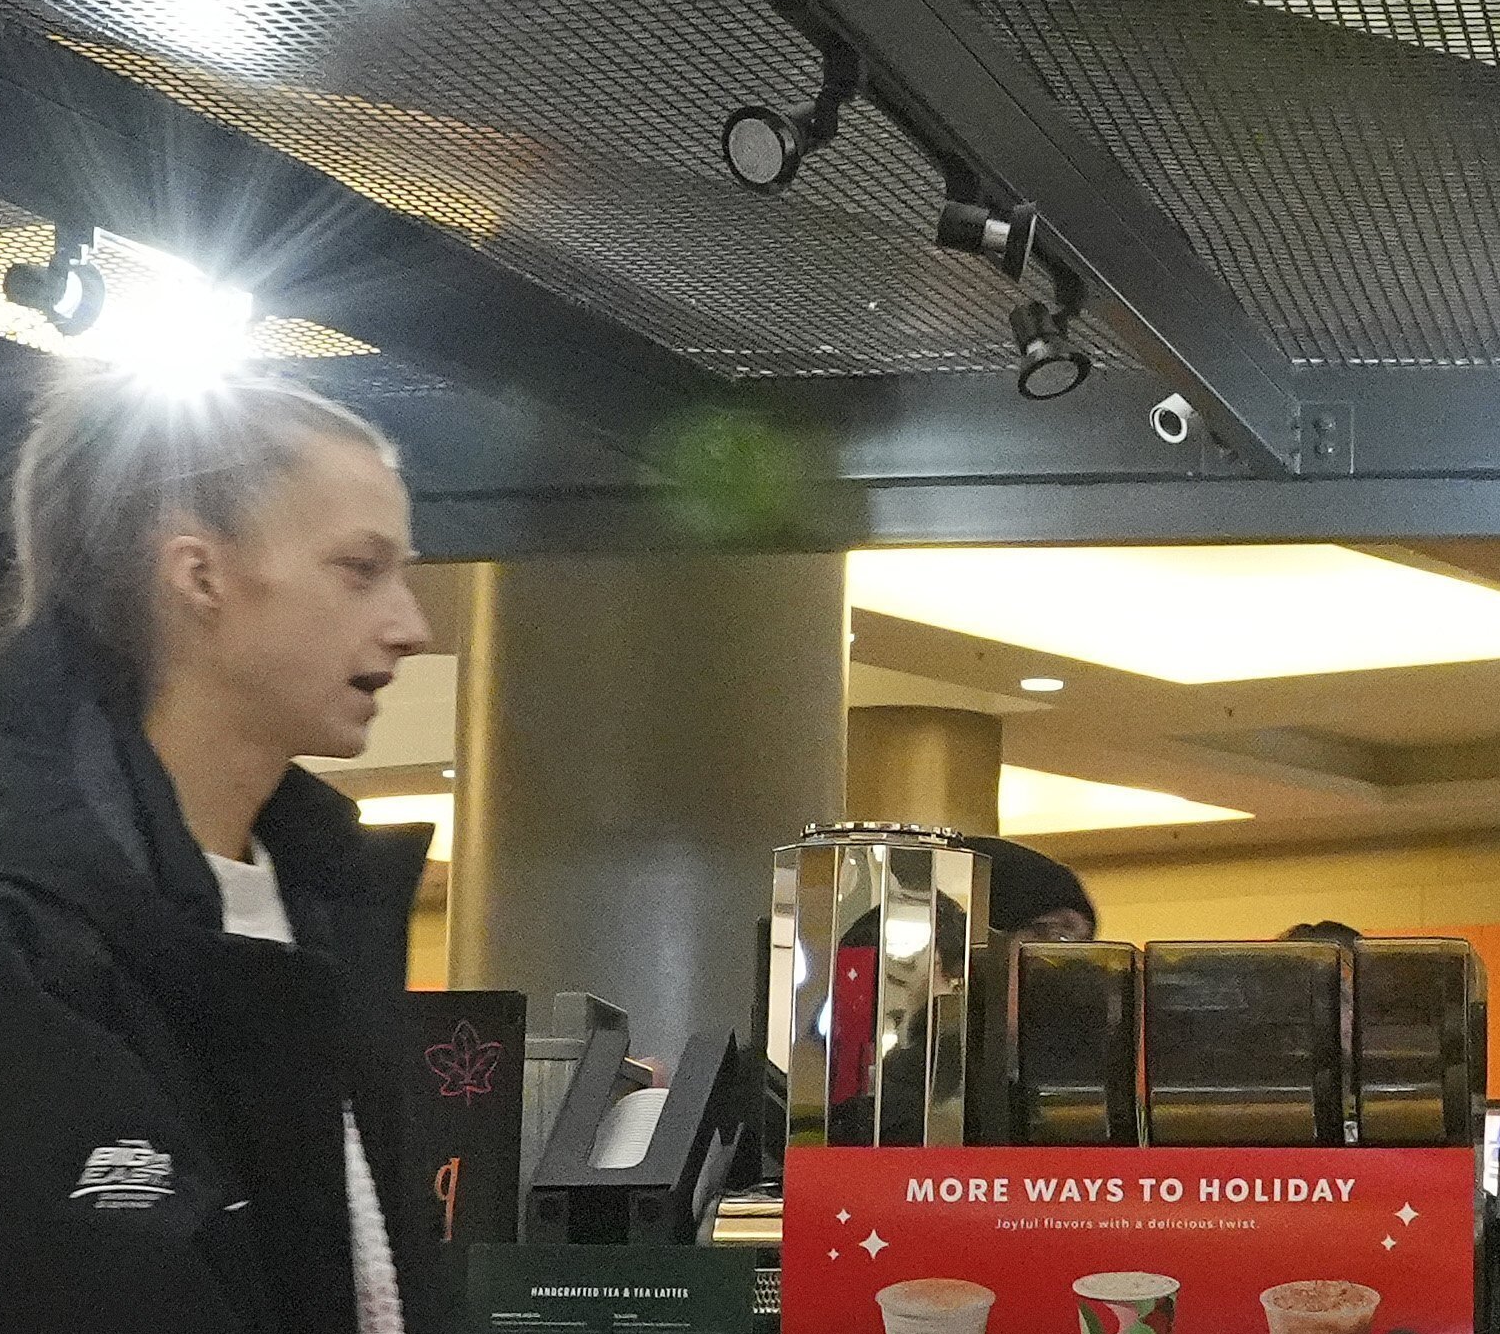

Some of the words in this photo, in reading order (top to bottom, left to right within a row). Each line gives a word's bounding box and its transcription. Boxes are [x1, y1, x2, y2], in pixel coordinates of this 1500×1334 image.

[905, 1178, 1010, 1202] MORE
[1024, 1178, 1125, 1203] WAYS
[1139, 1178, 1184, 1203] TO
[1198, 1178, 1356, 1202] HOLIDAY
[995, 1218, 1039, 1230] Joyful
[1044, 1218, 1093, 1229] flavors
[1098, 1218, 1130, 1229] with
[1135, 1221, 1143, 1229] a
[1147, 1217, 1213, 1229] delicious
[1218, 1218, 1260, 1229] twist.
[531, 1287, 599, 1297] HANDCRAFTED
[602, 1287, 620, 1297] TEA
[623, 1288, 630, 1297] &
[633, 1287, 651, 1297] TEA
[654, 1288, 689, 1298] LATTES
